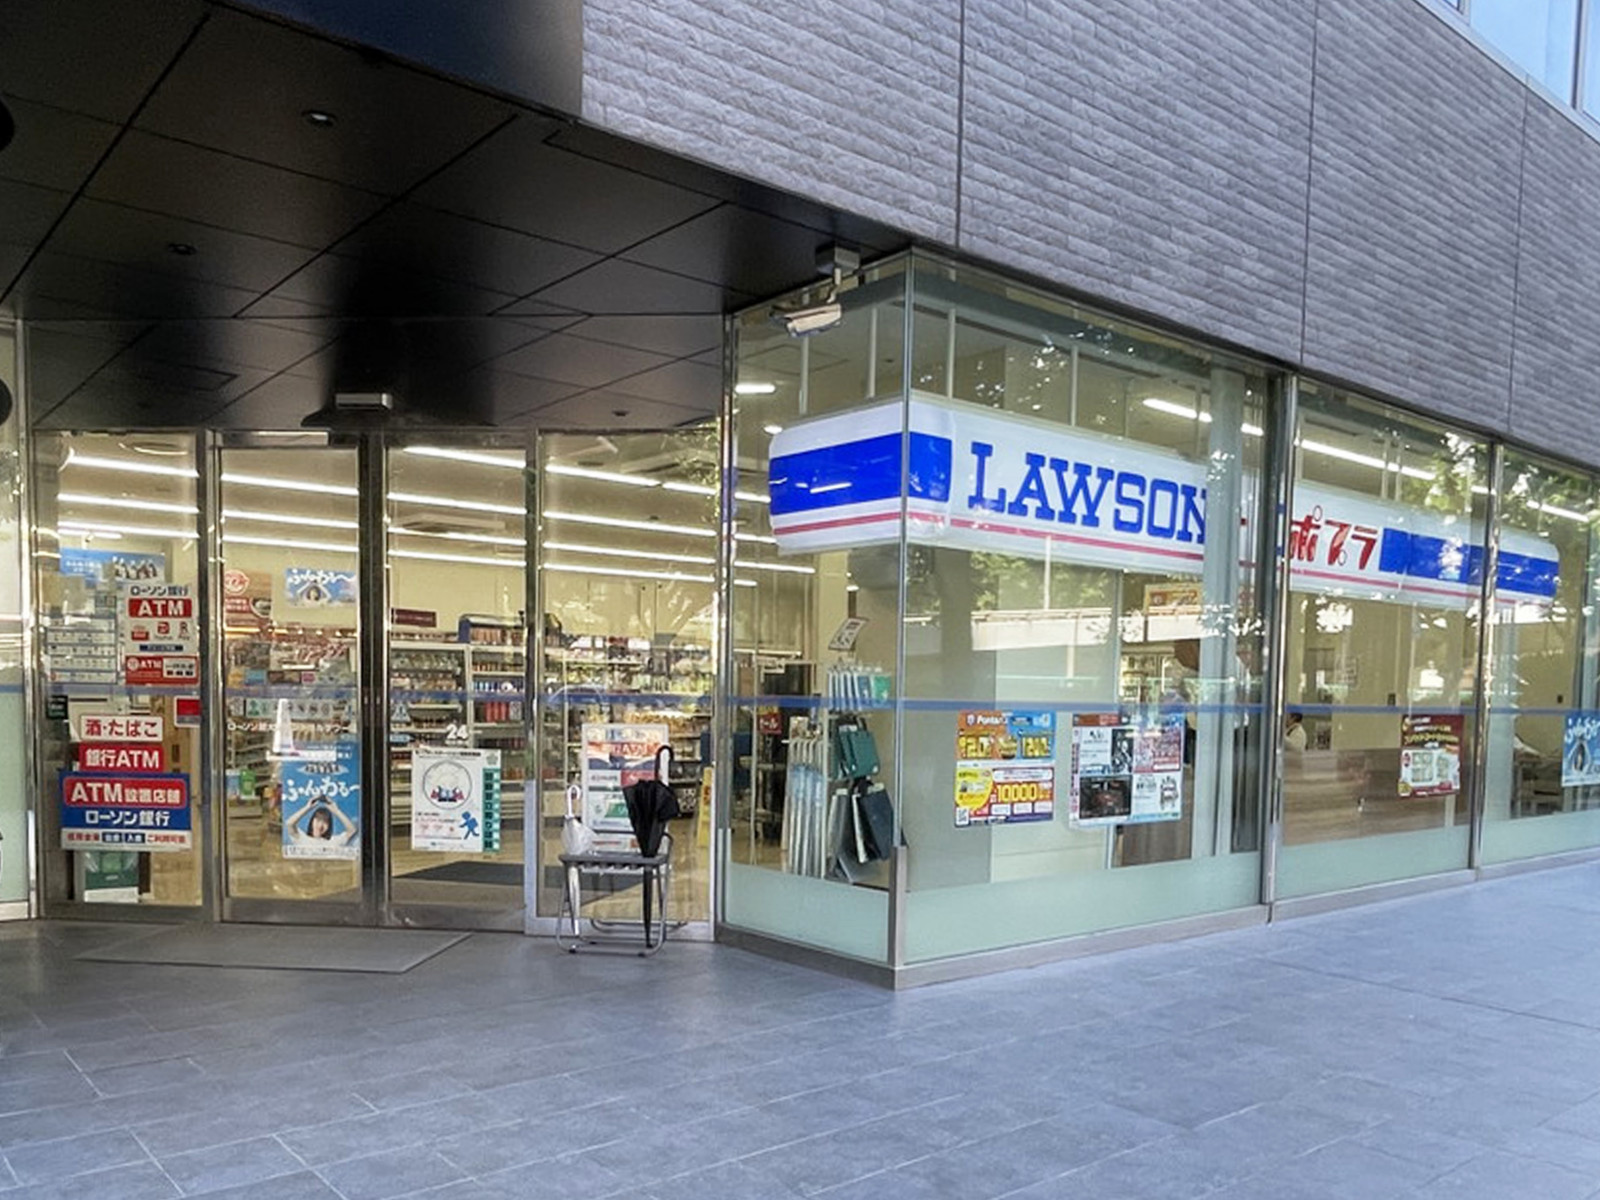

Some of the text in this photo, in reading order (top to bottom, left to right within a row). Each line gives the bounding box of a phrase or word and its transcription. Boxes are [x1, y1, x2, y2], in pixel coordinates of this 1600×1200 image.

[968, 441, 1206, 545] LAWSON
[1289, 504, 1378, 571] ポプラ
[138, 600, 184, 616] ATM
[85, 719, 159, 738] 酒・たばこ
[446, 724, 469, 740] 24
[85, 748, 160, 769] 銀行ATM
[85, 809, 171, 827] ローソン銀行
